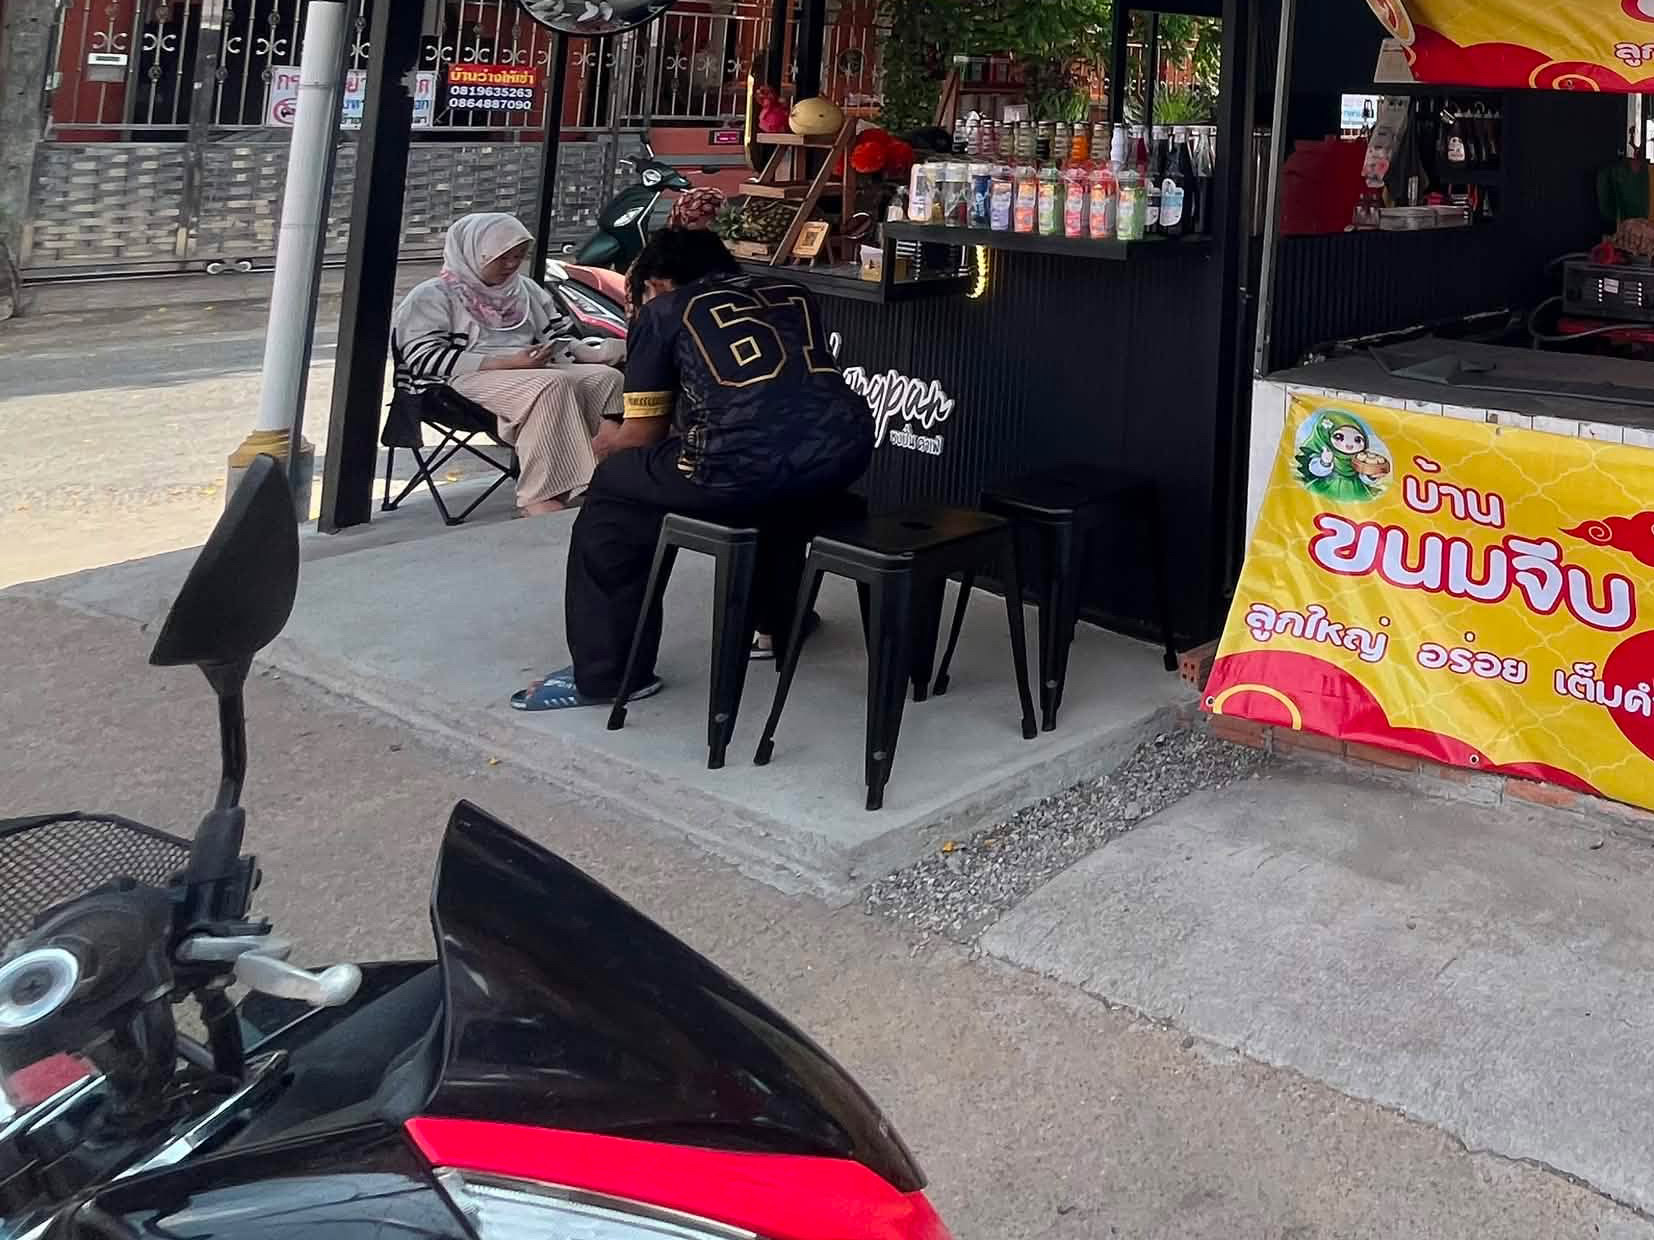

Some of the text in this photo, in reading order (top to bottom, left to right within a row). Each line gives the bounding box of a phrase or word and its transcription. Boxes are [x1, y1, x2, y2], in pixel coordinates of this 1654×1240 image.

[1402, 455, 1505, 528] บ้าน
[1310, 513, 1638, 632] ขนมจีบ
[1246, 599, 1392, 663] ลูกใหญ่
[1416, 627, 1529, 685] อร่อย
